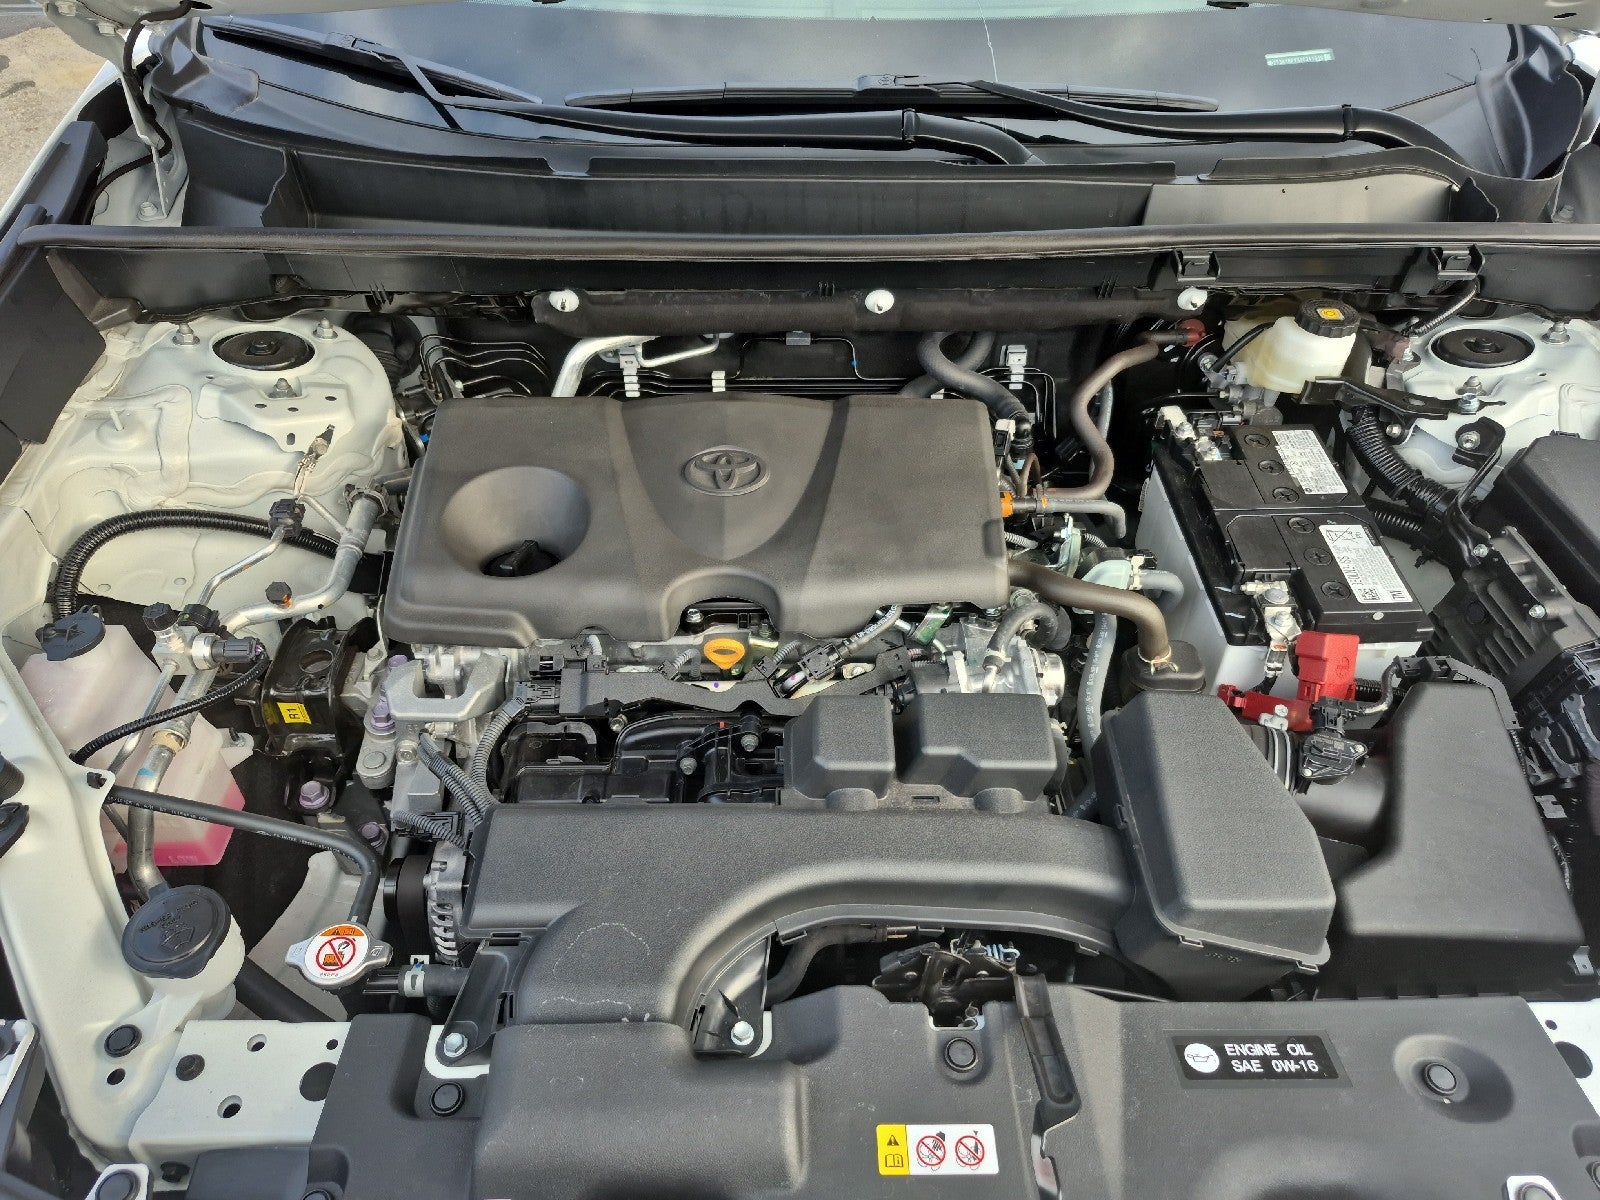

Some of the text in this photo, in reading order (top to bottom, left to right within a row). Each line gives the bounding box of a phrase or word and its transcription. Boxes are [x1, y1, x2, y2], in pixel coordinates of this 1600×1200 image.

[286, 709, 300, 718] R1
[1223, 1043, 1313, 1056] ENGINE OIL
[1231, 1059, 1319, 1073] SAE 0W-16
